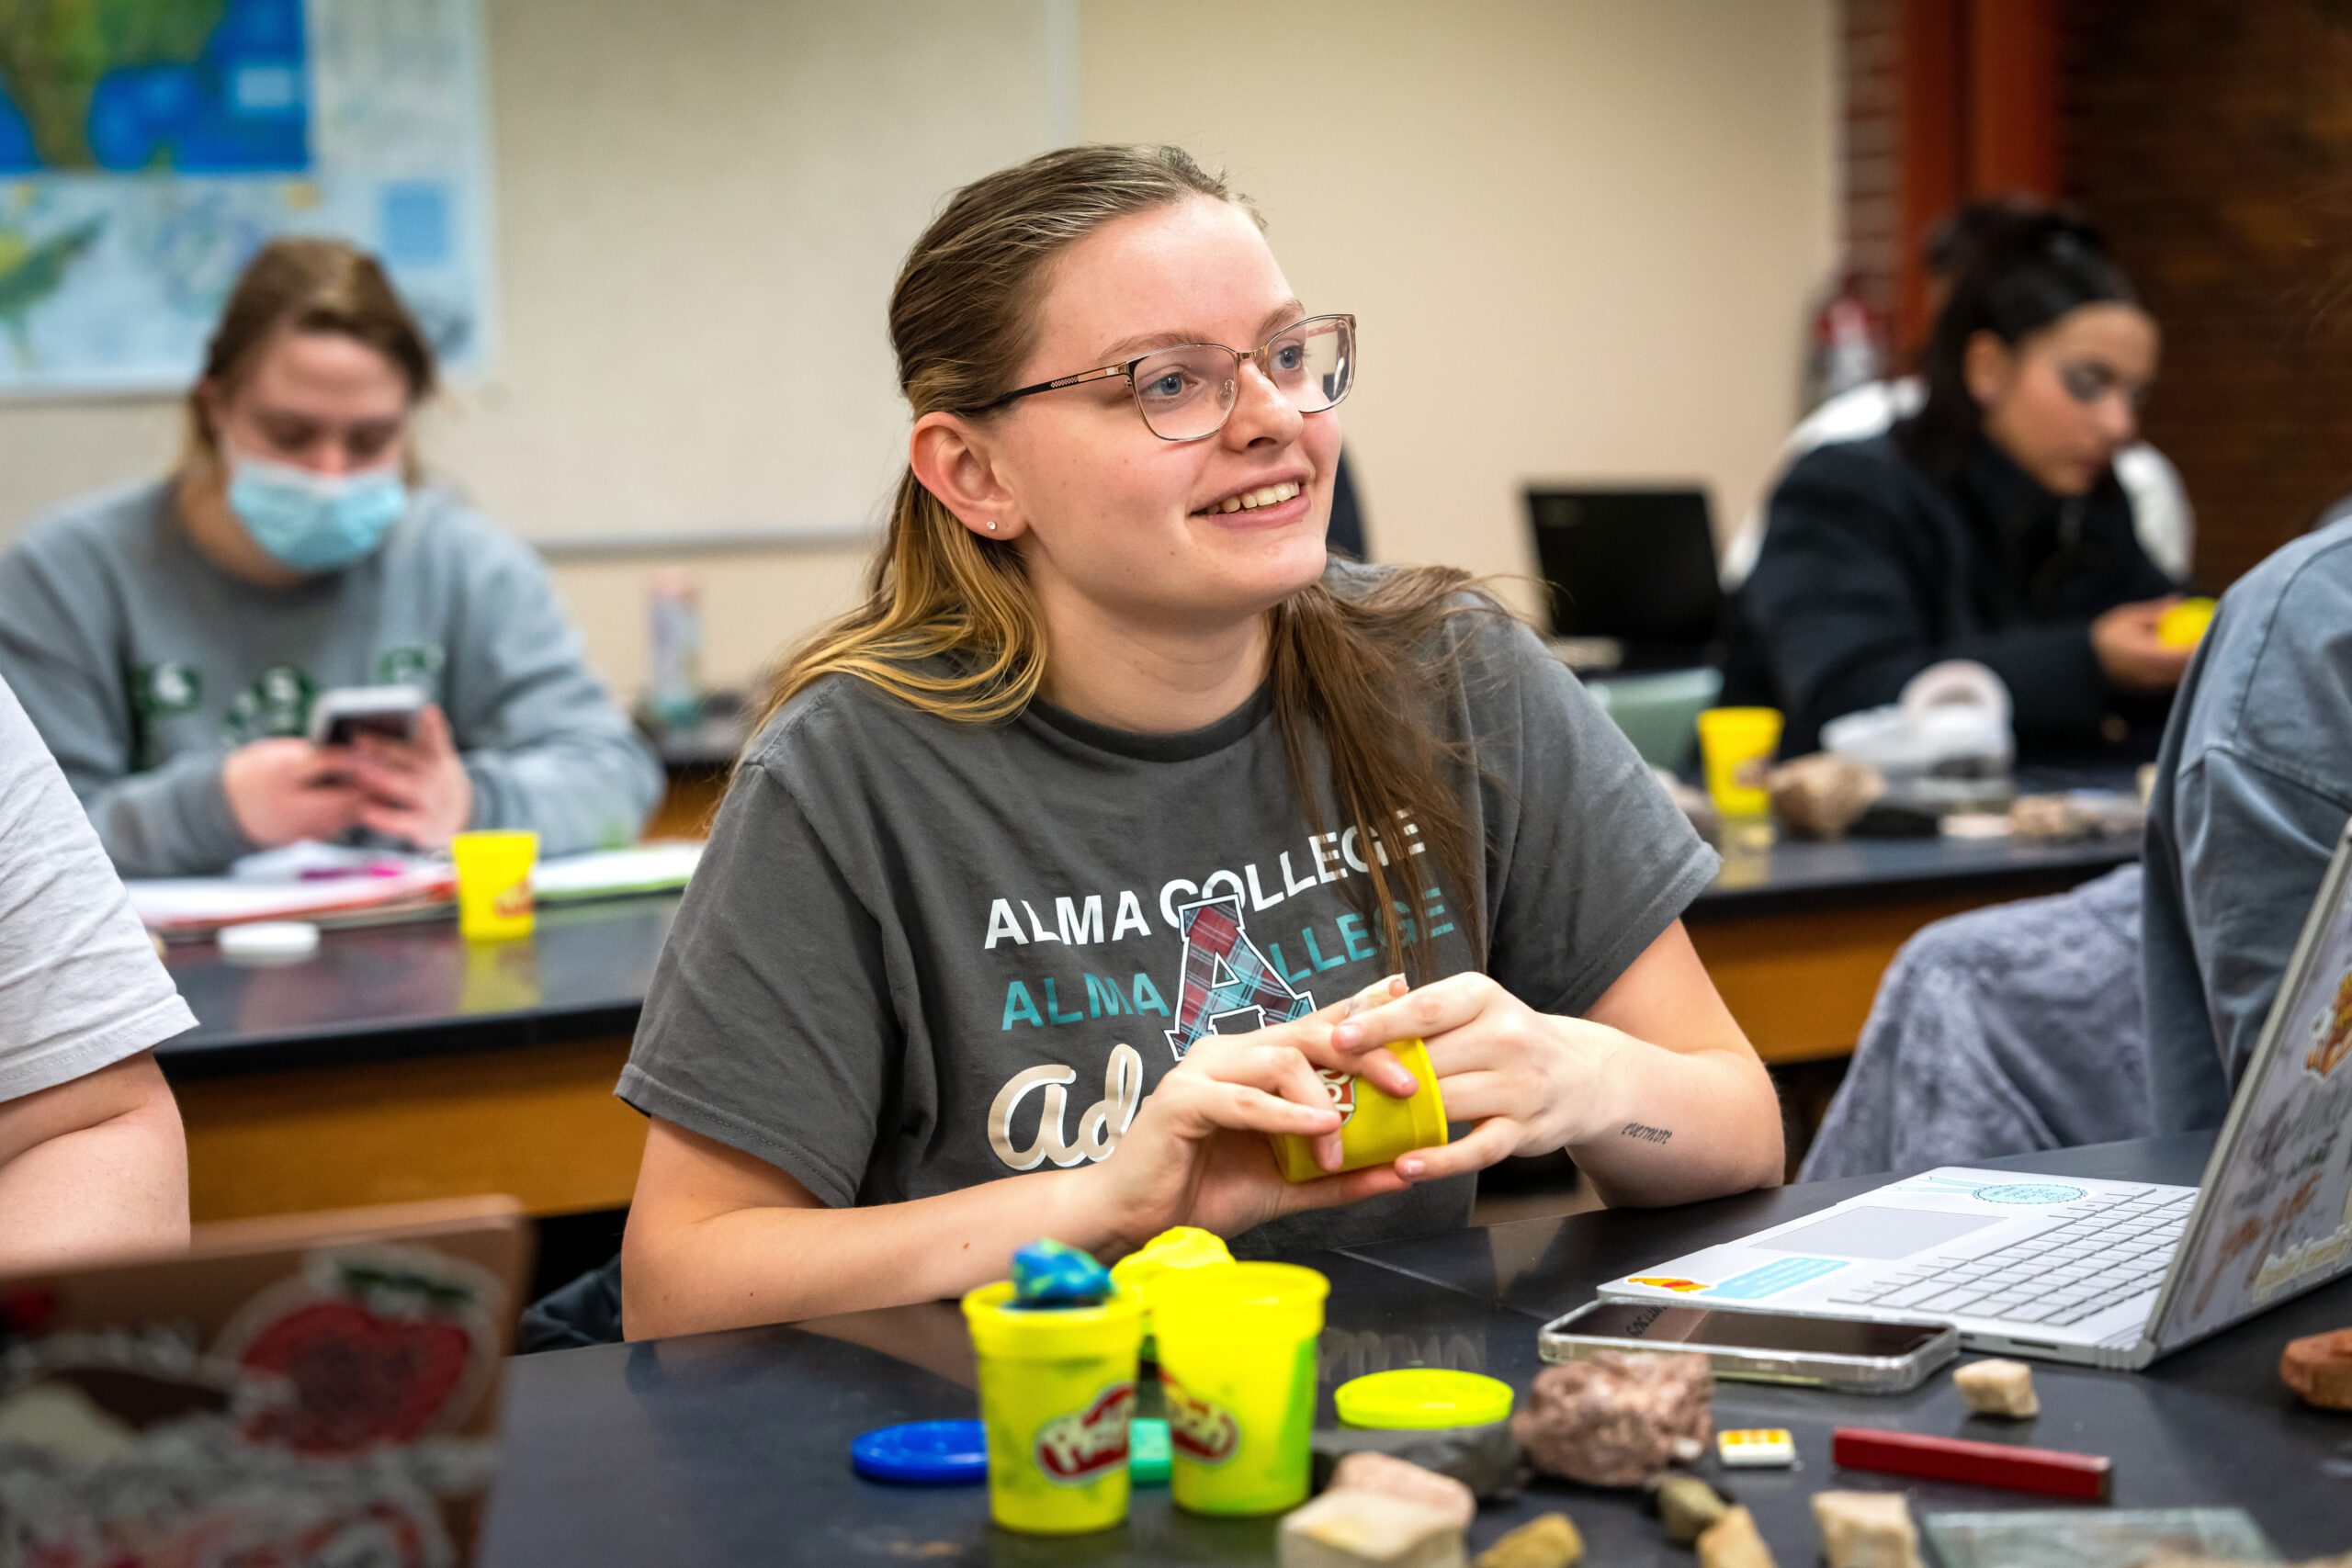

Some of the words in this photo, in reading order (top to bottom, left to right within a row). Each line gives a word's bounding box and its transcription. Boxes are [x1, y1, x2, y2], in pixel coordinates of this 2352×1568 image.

[985, 890, 1151, 950] ALMA
[1159, 809, 1426, 929] COLLEGE
[1001, 972, 1171, 1031] ALMA
[1269, 887, 1455, 986] LLEGE
